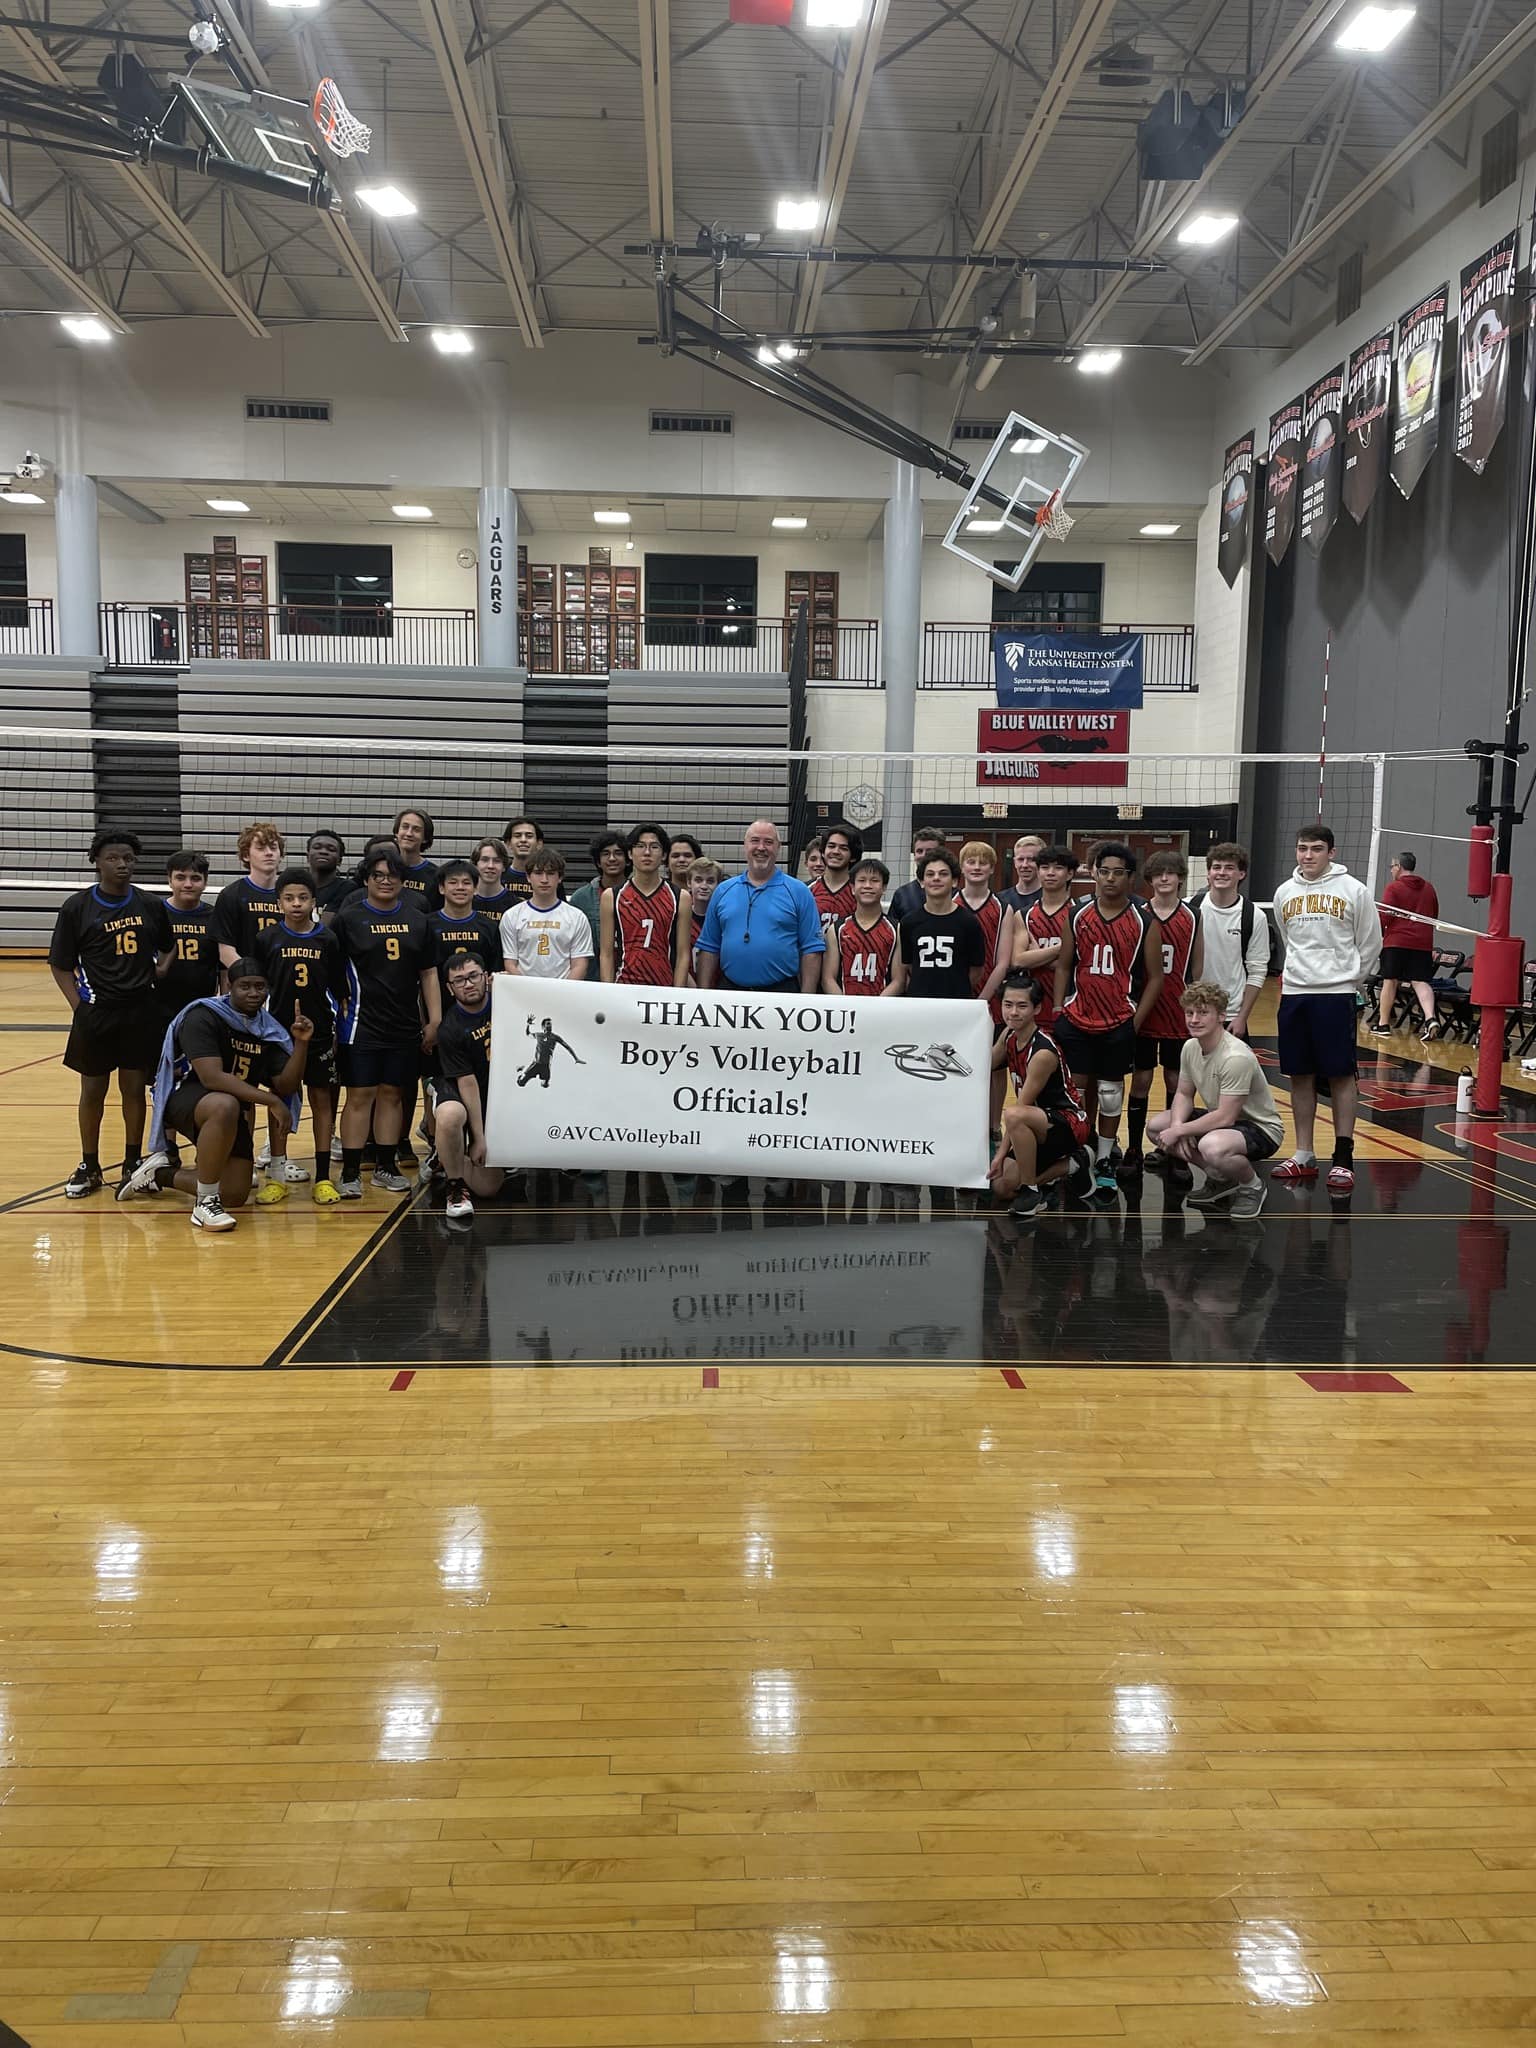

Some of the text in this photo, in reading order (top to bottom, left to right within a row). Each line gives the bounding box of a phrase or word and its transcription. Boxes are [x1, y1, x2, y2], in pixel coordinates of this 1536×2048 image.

[1457, 434, 1473, 451] 2017
[490, 517, 503, 614] JAGUARS
[1028, 649, 1116, 660] THE UNIVERSITY OF
[1028, 658, 1133, 669] KANSAS HEALTH SYSTEM
[1014, 677, 1032, 686] Sports
[1033, 677, 1056, 685] medicine
[1089, 678, 1109, 686] training
[1014, 686, 1035, 694] provider
[1056, 686, 1071, 695] Valley
[1088, 686, 1110, 695] Jaguars
[992, 714, 1117, 730] BLUE VALLEY WEST
[985, 751, 1039, 778] JAGUARS
[403, 880, 425, 891] COLN
[505, 883, 533, 893] LINCOL
[1306, 893, 1346, 920] VALLEY
[104, 915, 143, 933] LINCOLN
[172, 924, 206, 934] INCOLN
[370, 924, 409, 934] LINCOLN
[642, 919, 653, 948] 7
[115, 931, 138, 955] 16
[442, 932, 479, 941] LINCOLN
[537, 933, 550, 955] 2
[177, 939, 199, 960] 12
[281, 948, 321, 959] LINCOLN
[386, 938, 400, 960] 9
[917, 936, 954, 968] 25
[1090, 944, 1114, 975] 10
[295, 963, 308, 987] 3
[850, 953, 877, 982] 44
[638, 1001, 856, 1034] THANK YOU!
[620, 1041, 861, 1080] Boy's Volleyball
[673, 1087, 808, 1116] Officials!
[548, 1125, 935, 1155] @AVCAVolleyball #OFFICIATIONWEEK
